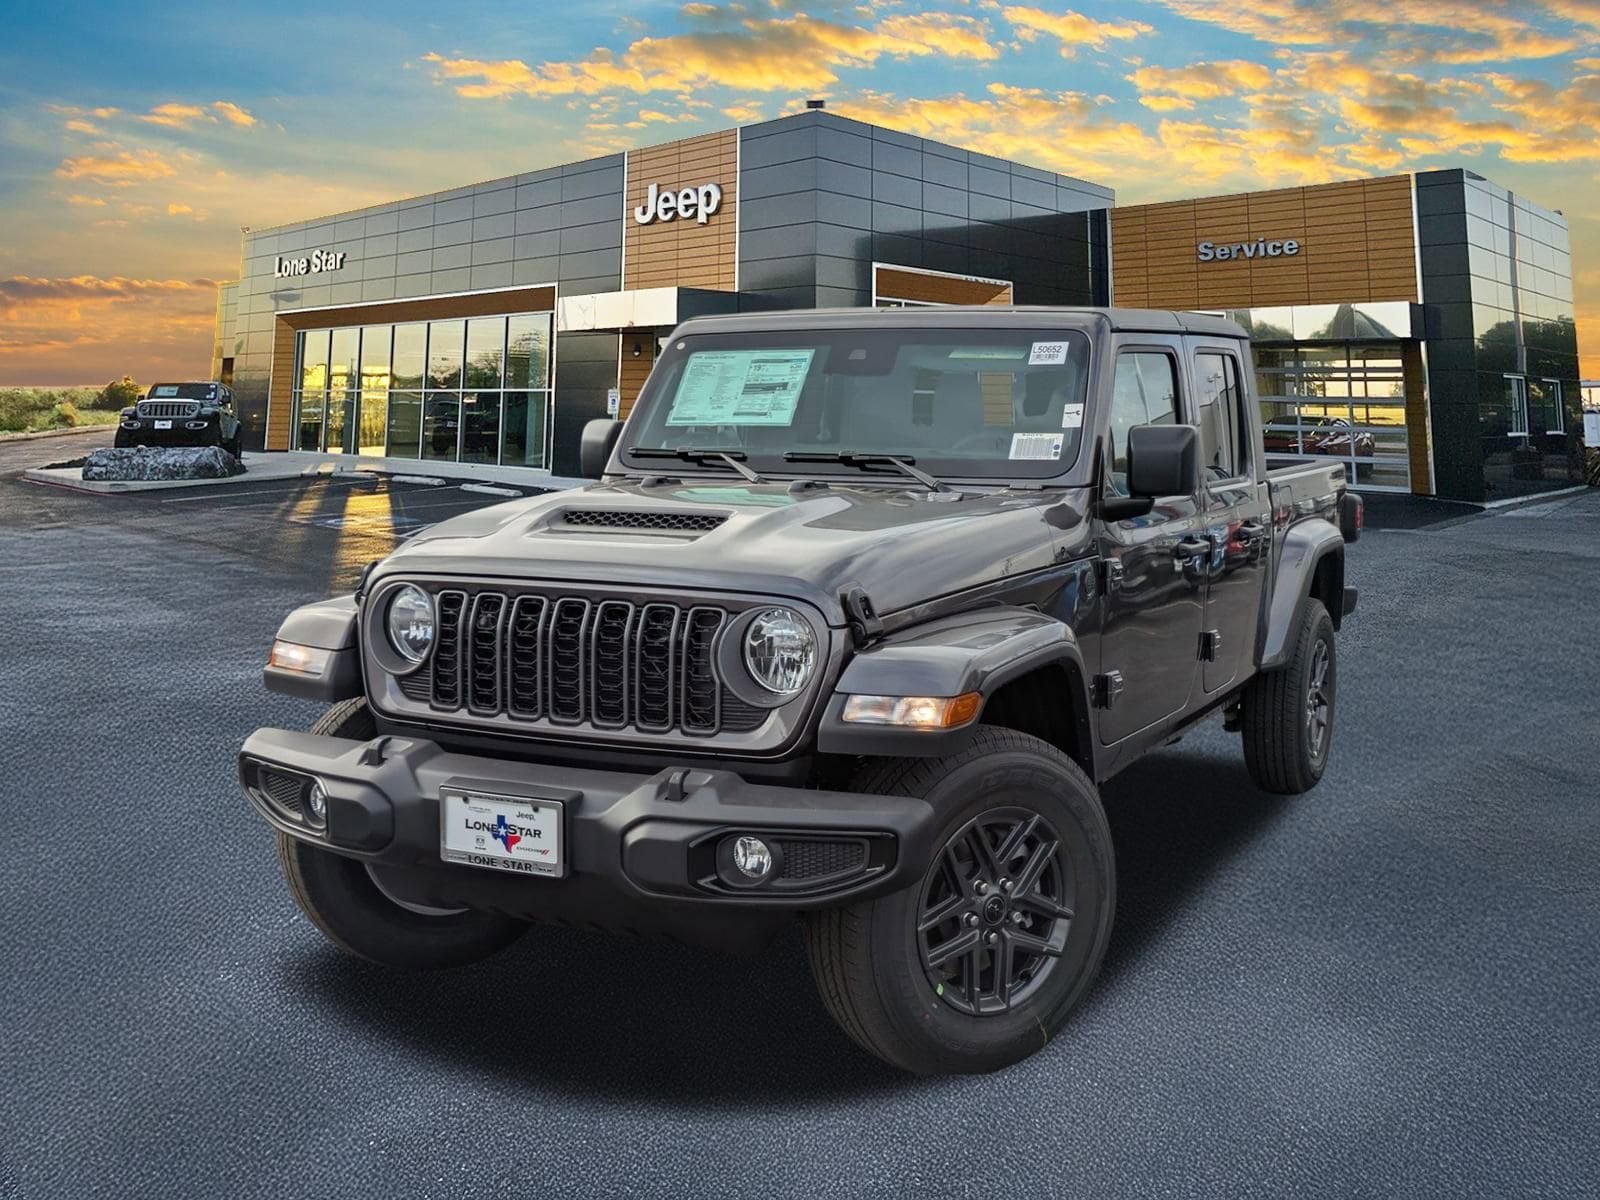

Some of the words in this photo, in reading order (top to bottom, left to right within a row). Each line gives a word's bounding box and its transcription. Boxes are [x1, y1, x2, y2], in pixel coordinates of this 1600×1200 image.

[634, 183, 722, 225] Jeep
[1198, 237, 1299, 261] Service
[274, 257, 309, 278] Lone
[311, 249, 346, 273] Star
[465, 818, 498, 833] LONE
[507, 823, 542, 839] STAR
[468, 854, 497, 867] LONE
[503, 859, 533, 872] STAR
